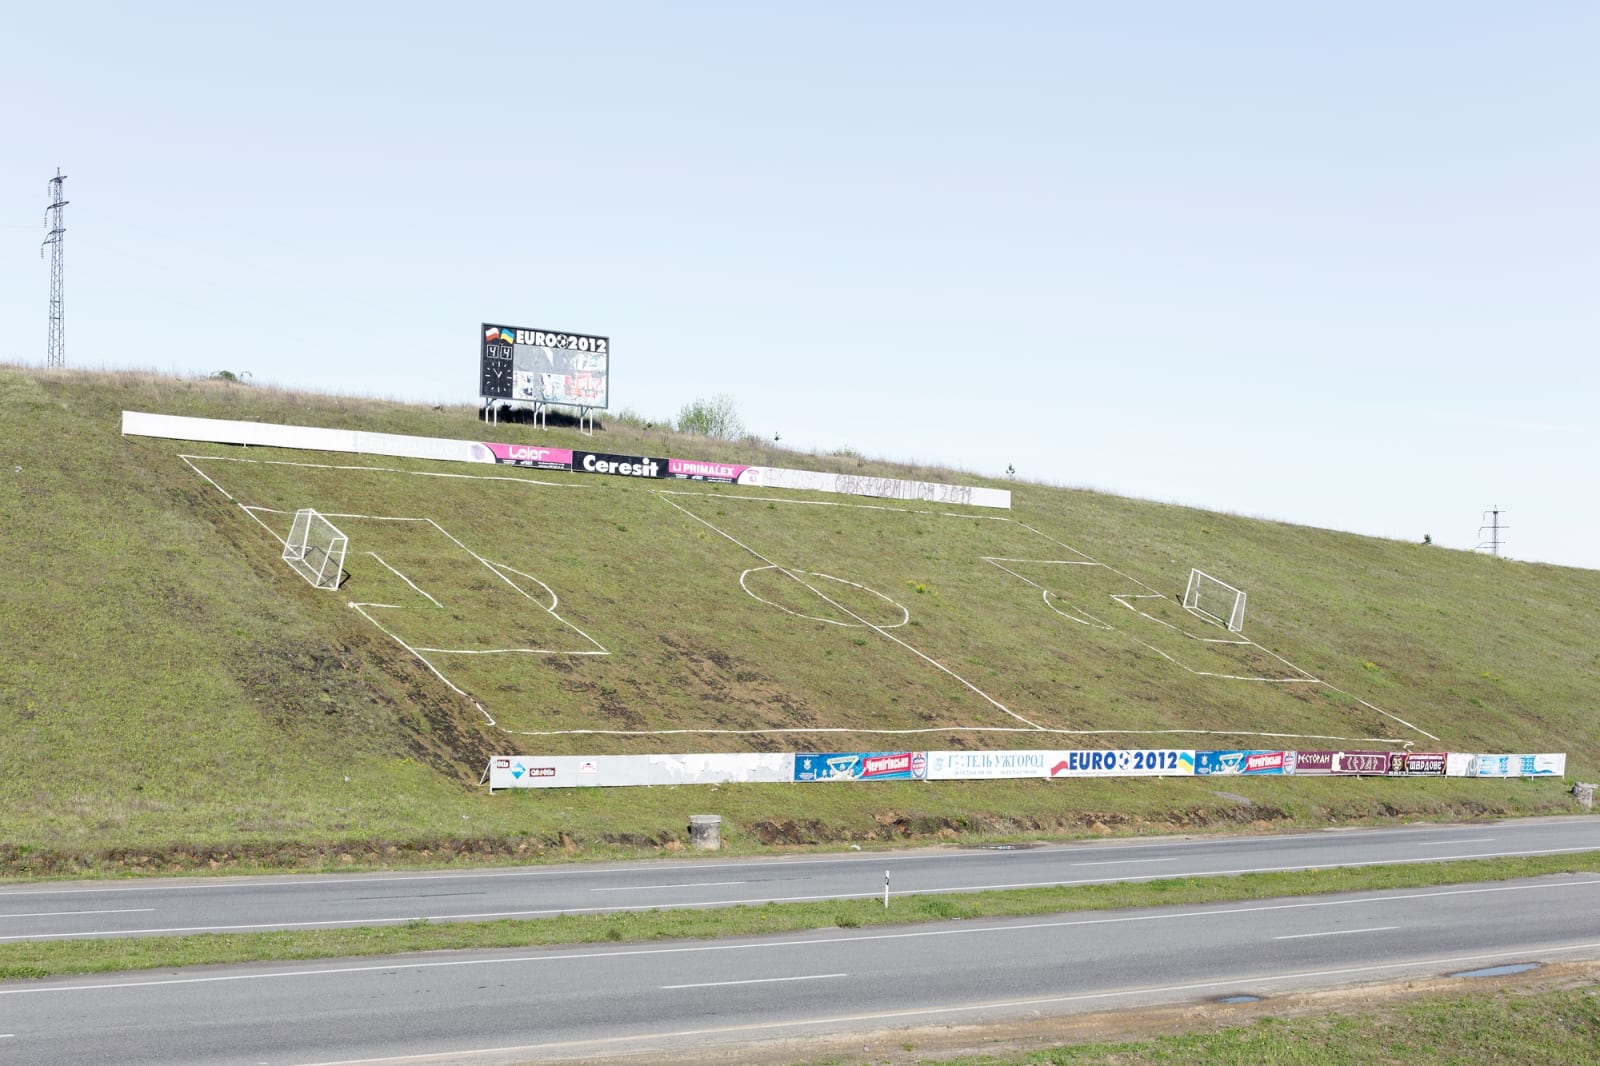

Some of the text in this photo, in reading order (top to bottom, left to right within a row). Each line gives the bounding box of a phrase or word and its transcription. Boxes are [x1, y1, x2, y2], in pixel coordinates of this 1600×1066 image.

[516, 329, 606, 352] EURO 2012
[583, 454, 659, 477] Ceresit
[683, 462, 734, 477] PRIMALEX
[995, 754, 1044, 768] УЖГОРОД
[1069, 751, 1177, 770] EURO 2012
